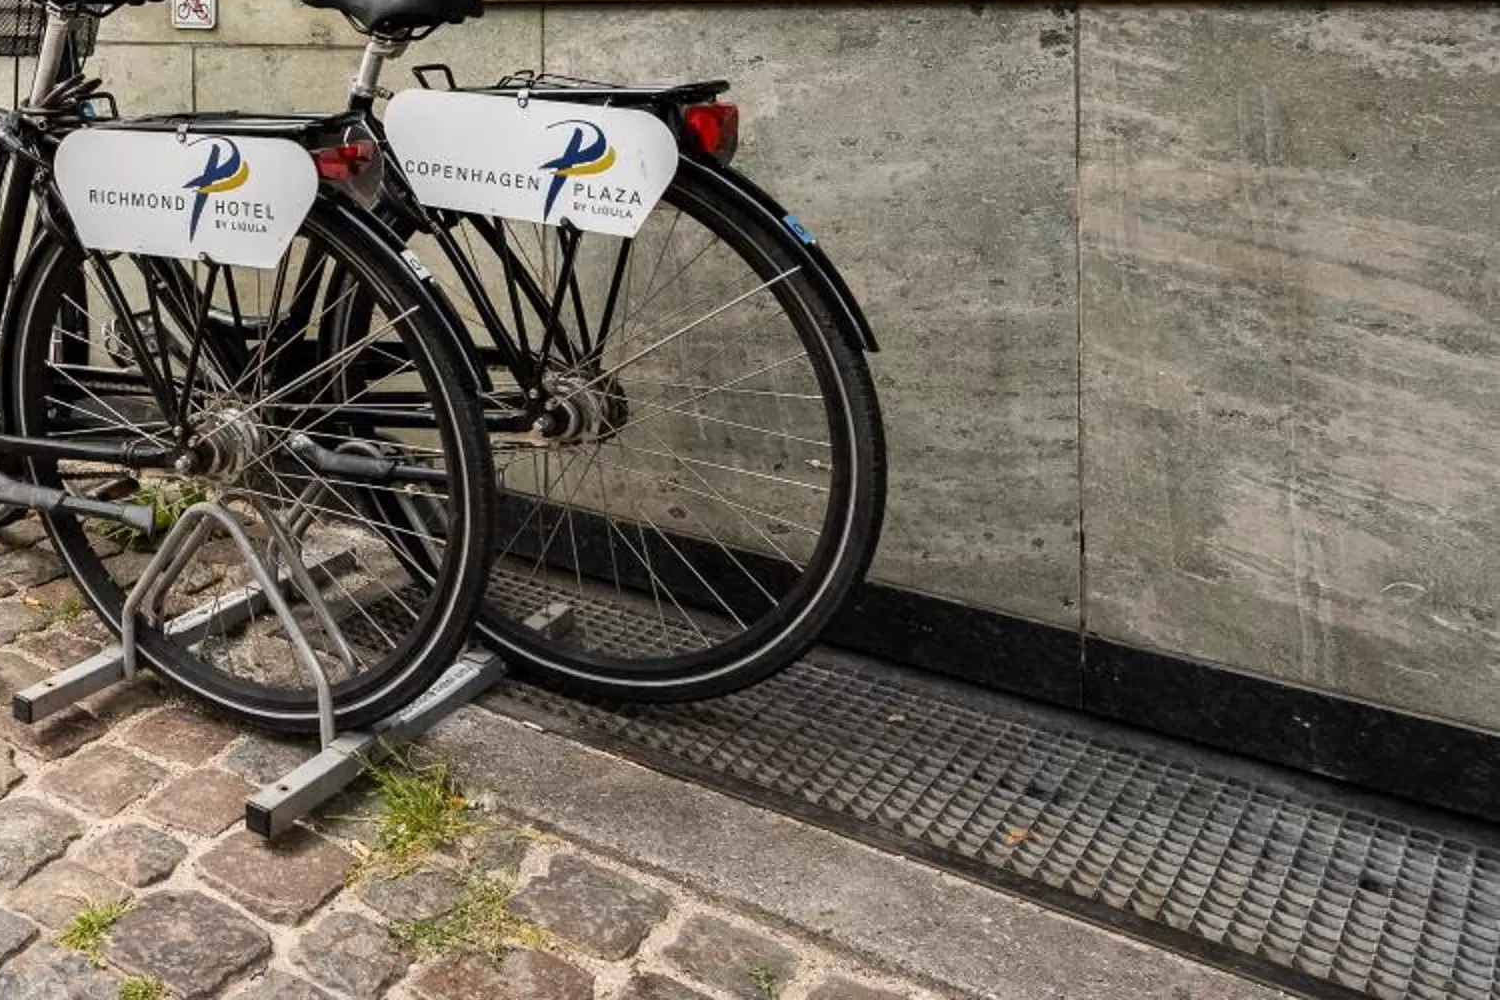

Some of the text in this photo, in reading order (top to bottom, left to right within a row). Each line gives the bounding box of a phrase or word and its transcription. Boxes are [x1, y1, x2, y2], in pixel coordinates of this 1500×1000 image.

[405, 159, 642, 206] COPENHAGEN PLAZA
[89, 188, 274, 220] RICHMOND HOTEL
[573, 201, 586, 212] BY
[214, 219, 227, 229] BY
